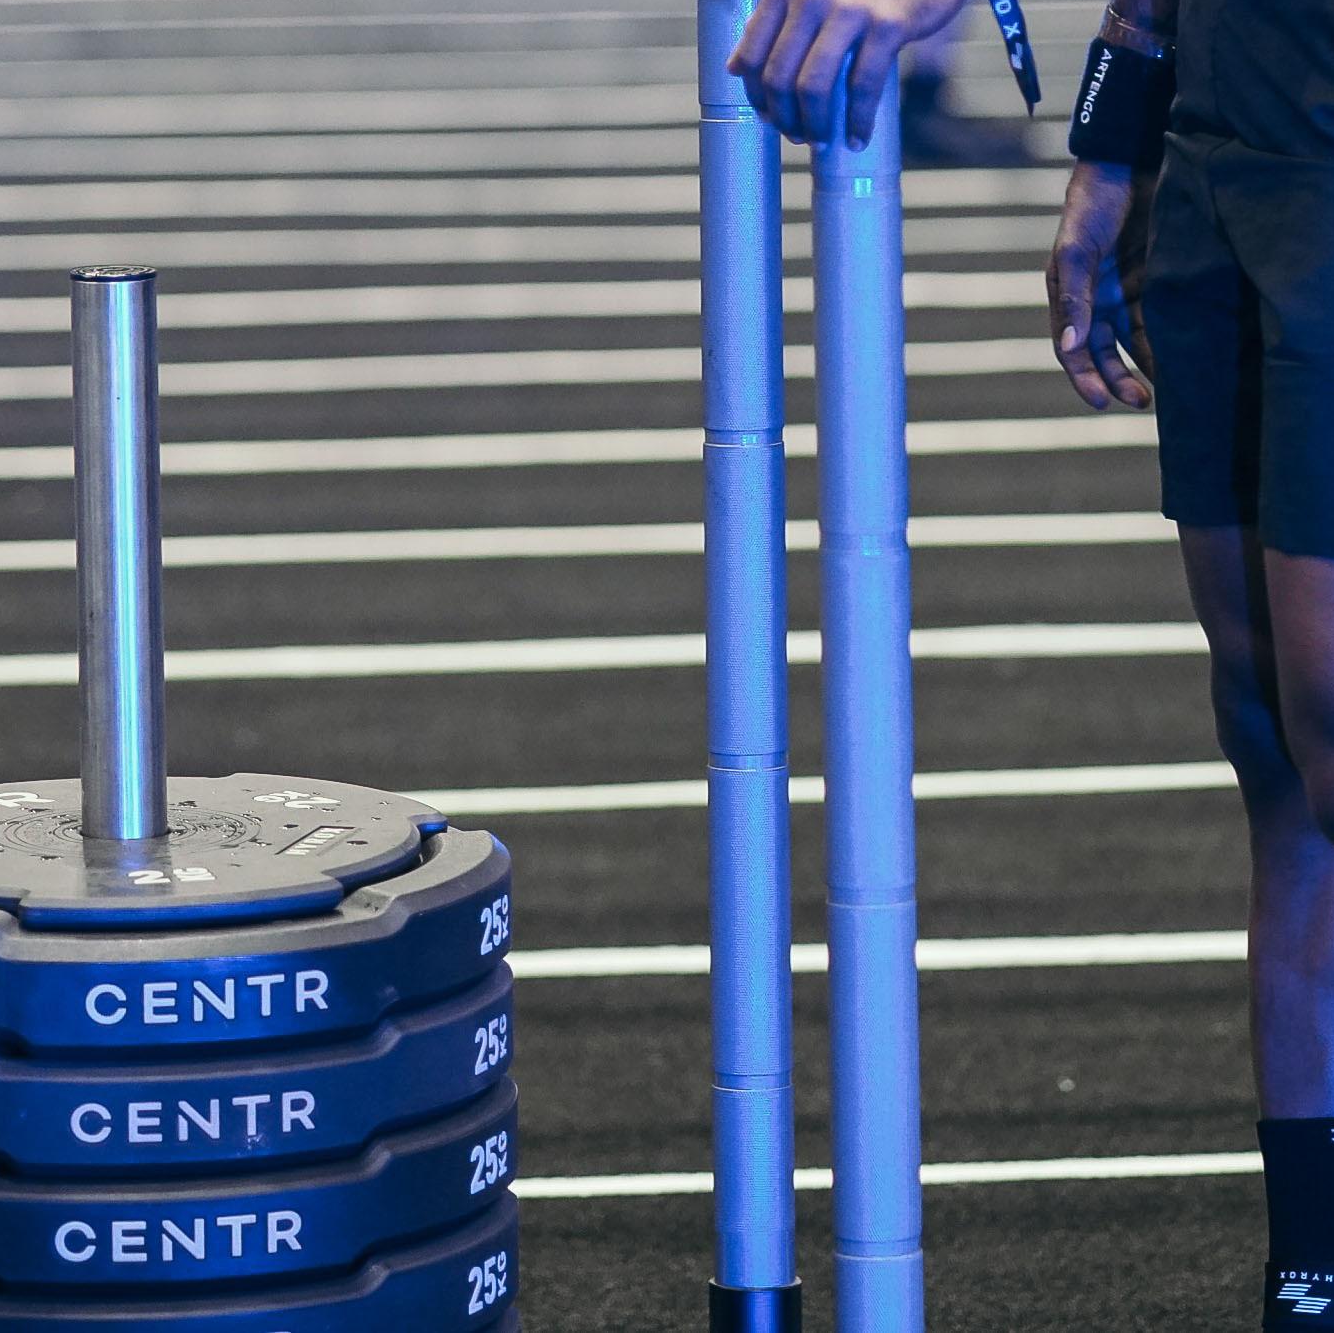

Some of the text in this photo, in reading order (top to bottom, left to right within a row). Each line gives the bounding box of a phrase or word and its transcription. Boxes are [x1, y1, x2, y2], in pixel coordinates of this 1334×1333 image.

[1080, 48, 1113, 124] ARTENGO
[127, 870, 172, 885] 2
[480, 898, 502, 956] 25
[85, 969, 329, 1026] CENTR
[474, 1017, 499, 1076] 25
[70, 1090, 317, 1144] CENTR
[470, 1135, 498, 1195] 25
[54, 1209, 302, 1264] CENTR
[468, 1251, 507, 1316] 25 KG
[1280, 1271, 1334, 1283] HYROX
